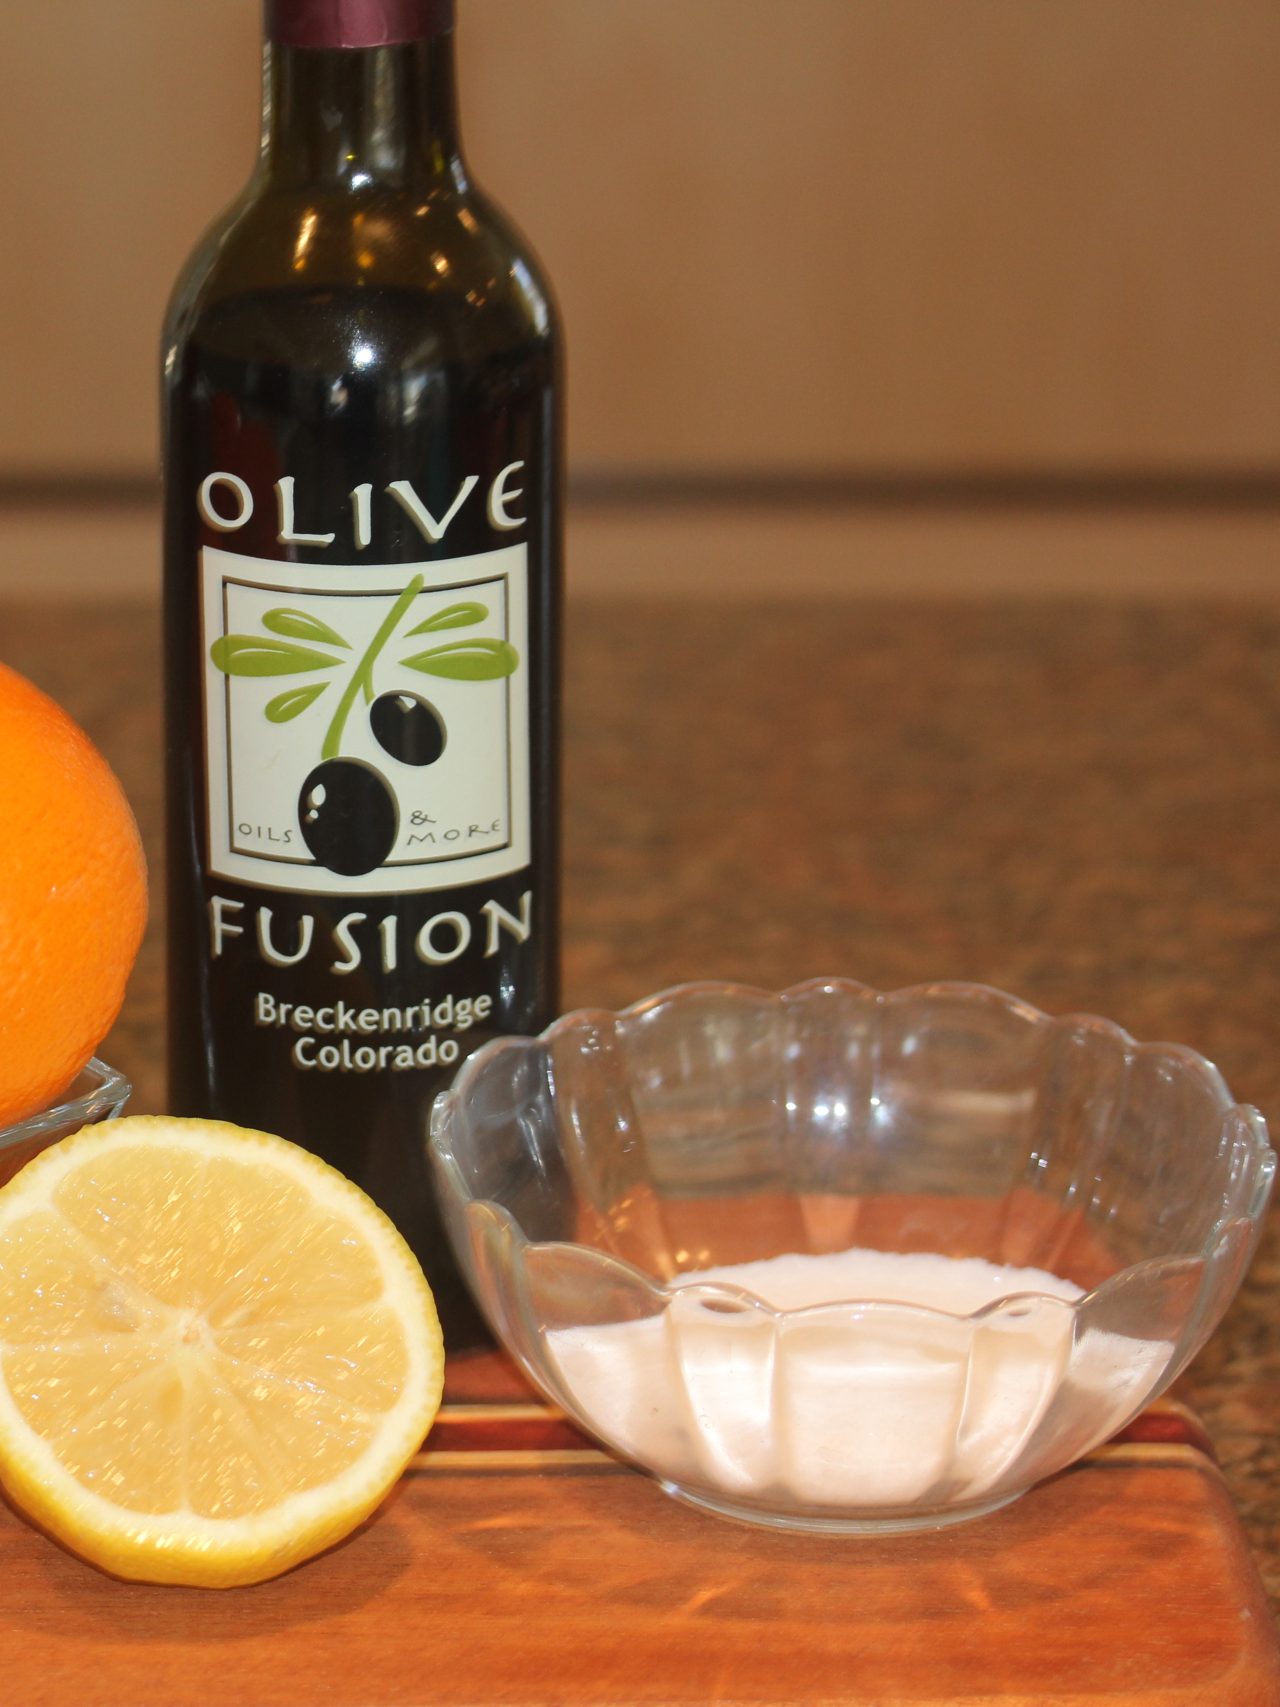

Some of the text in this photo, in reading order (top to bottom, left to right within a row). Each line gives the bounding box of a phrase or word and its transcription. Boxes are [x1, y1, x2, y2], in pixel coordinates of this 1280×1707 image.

[197, 460, 527, 550] OLIVE
[238, 822, 293, 844] OILS
[406, 819, 502, 847] MORE
[410, 810, 437, 826] &
[209, 890, 533, 975] FUSION
[255, 992, 493, 1034] Breckenridge
[292, 1034, 460, 1072] Colorado
